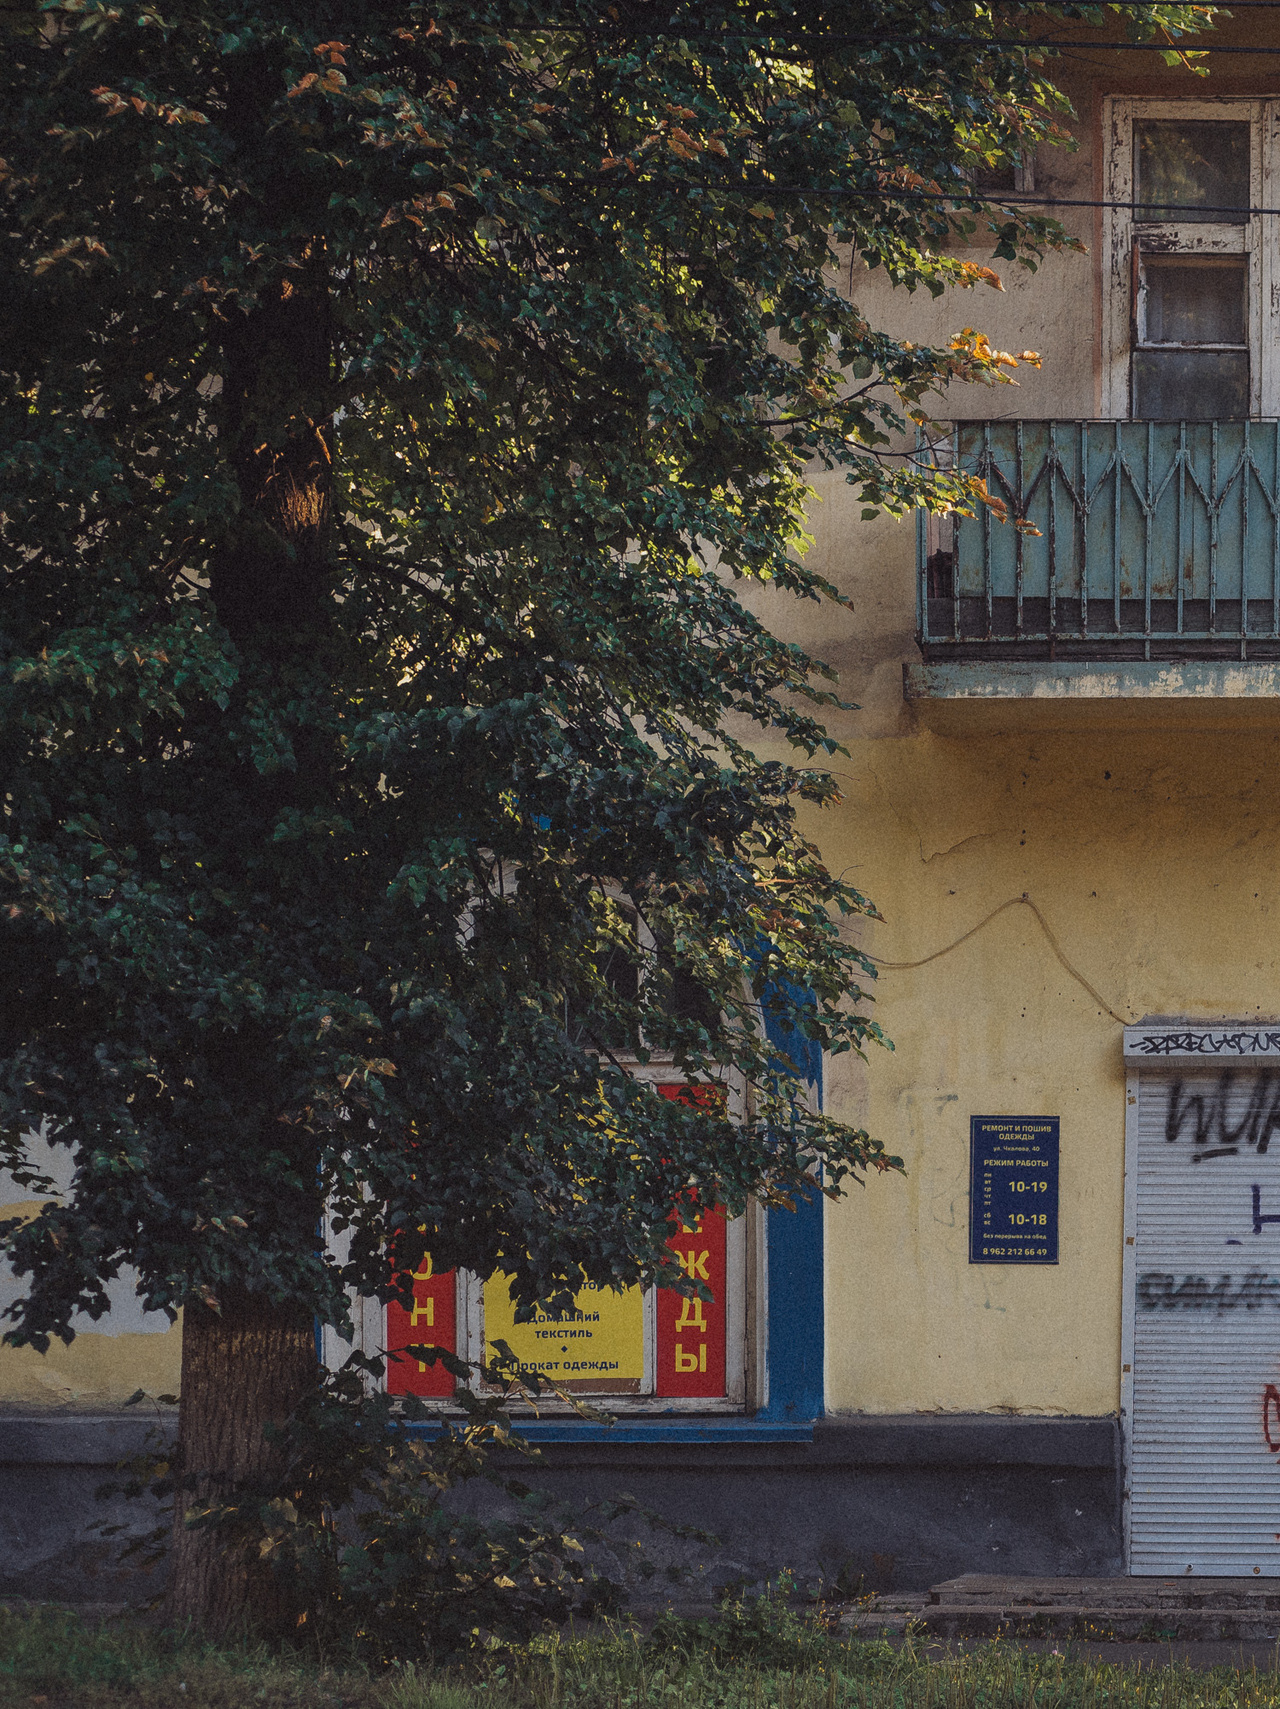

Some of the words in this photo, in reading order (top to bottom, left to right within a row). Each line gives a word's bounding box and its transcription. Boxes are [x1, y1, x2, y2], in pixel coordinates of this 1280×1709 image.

[981, 1124, 1014, 1132] РЕМОНТ
[1022, 1125, 1052, 1133] ПОШИВ
[983, 1159, 1015, 1167] РЕЖИМ
[1015, 1159, 1049, 1167] РАБОТЫ
[1008, 1181, 1048, 1193] 10-19
[1008, 1213, 1047, 1225] 10-18
[983, 1247, 989, 1255] 8
[990, 1248, 1006, 1256] 962
[1007, 1248, 1023, 1256] 212
[1024, 1248, 1035, 1256] 66
[1036, 1248, 1048, 1256] 49
[534, 1329, 594, 1339] текстиль
[563, 1361, 619, 1372] одежды
